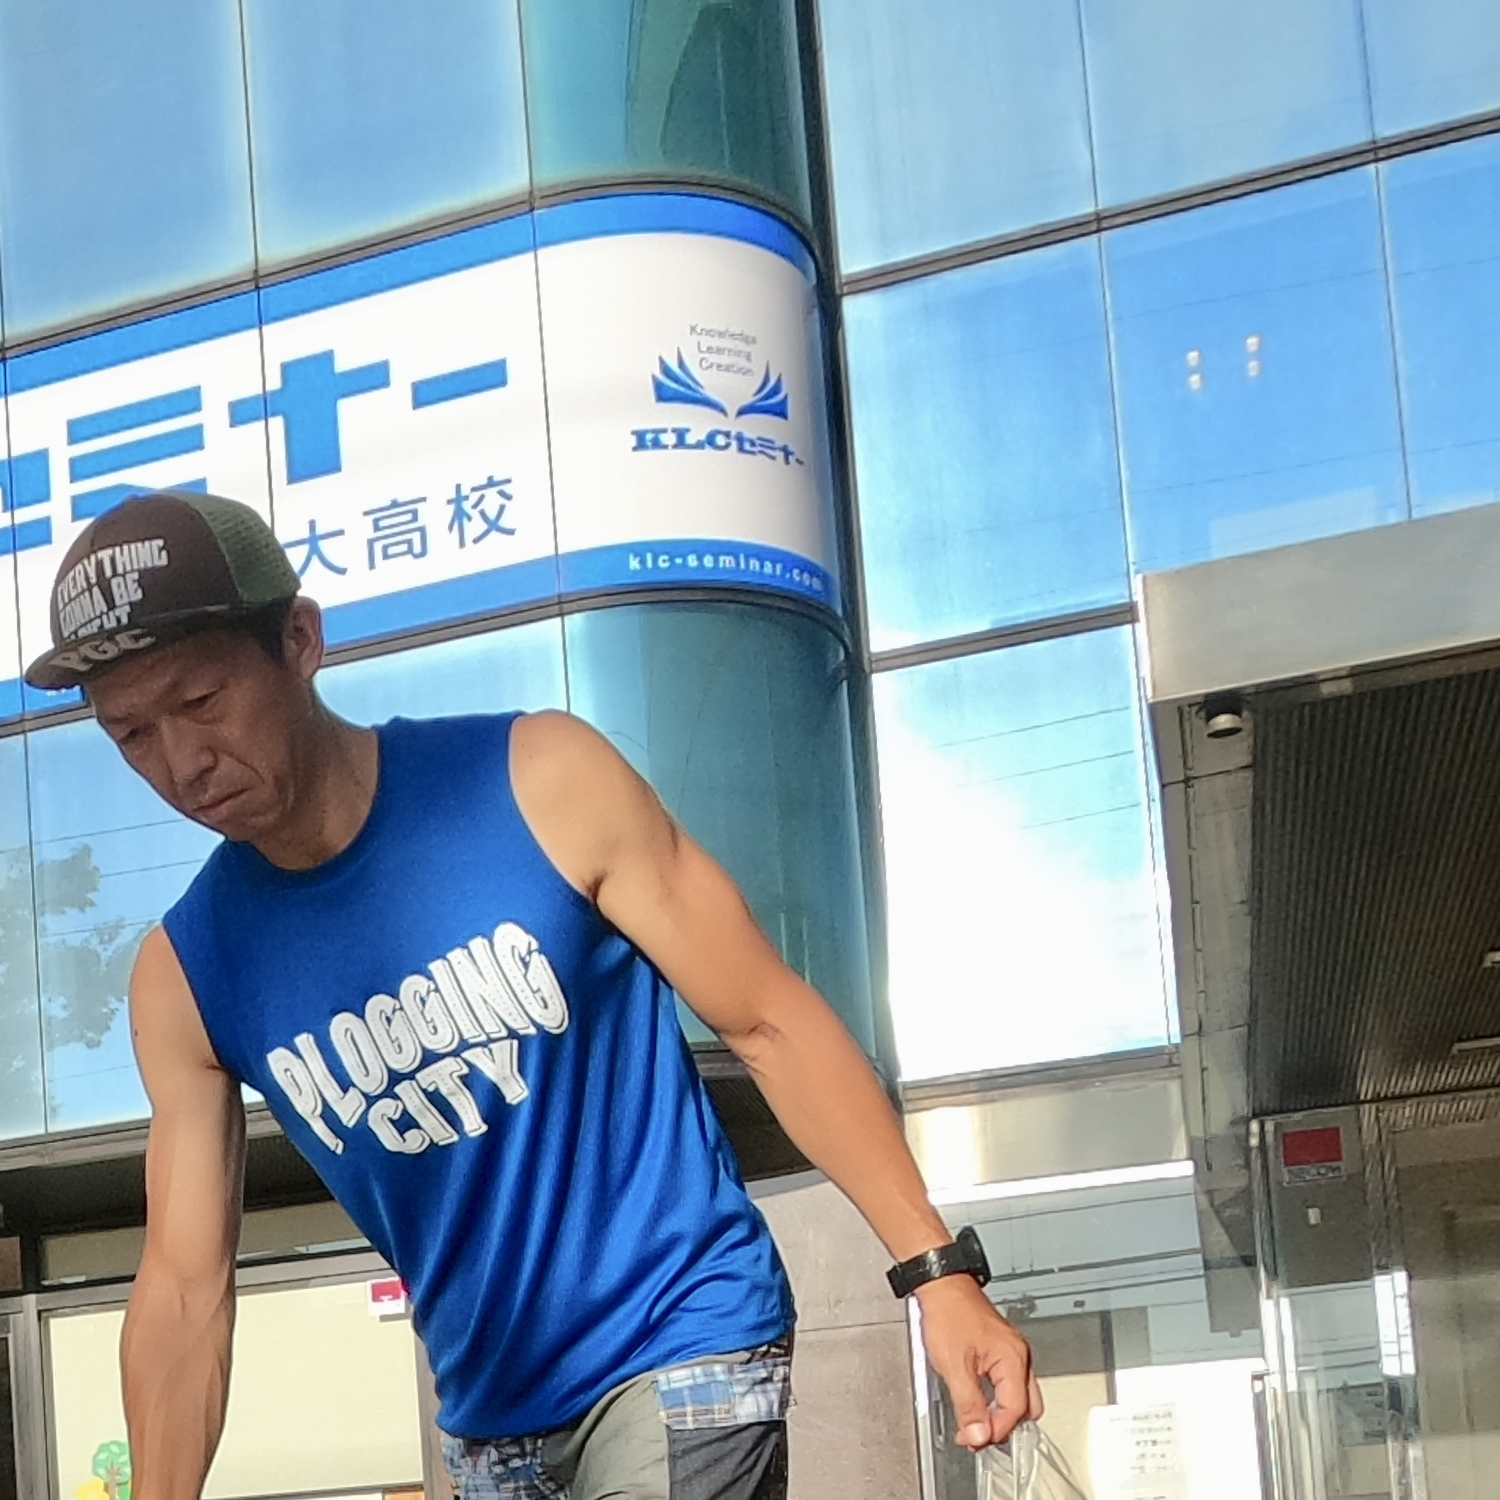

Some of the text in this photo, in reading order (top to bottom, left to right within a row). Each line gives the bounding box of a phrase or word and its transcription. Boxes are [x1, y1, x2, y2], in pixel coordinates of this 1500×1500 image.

[630, 426, 805, 466] KLCセミナー
[110, 570, 144, 608] BE
[628, 552, 824, 592] klc-seminar.com
[266, 922, 569, 1155] PLOGGING
[367, 1038, 530, 1154] CITY
